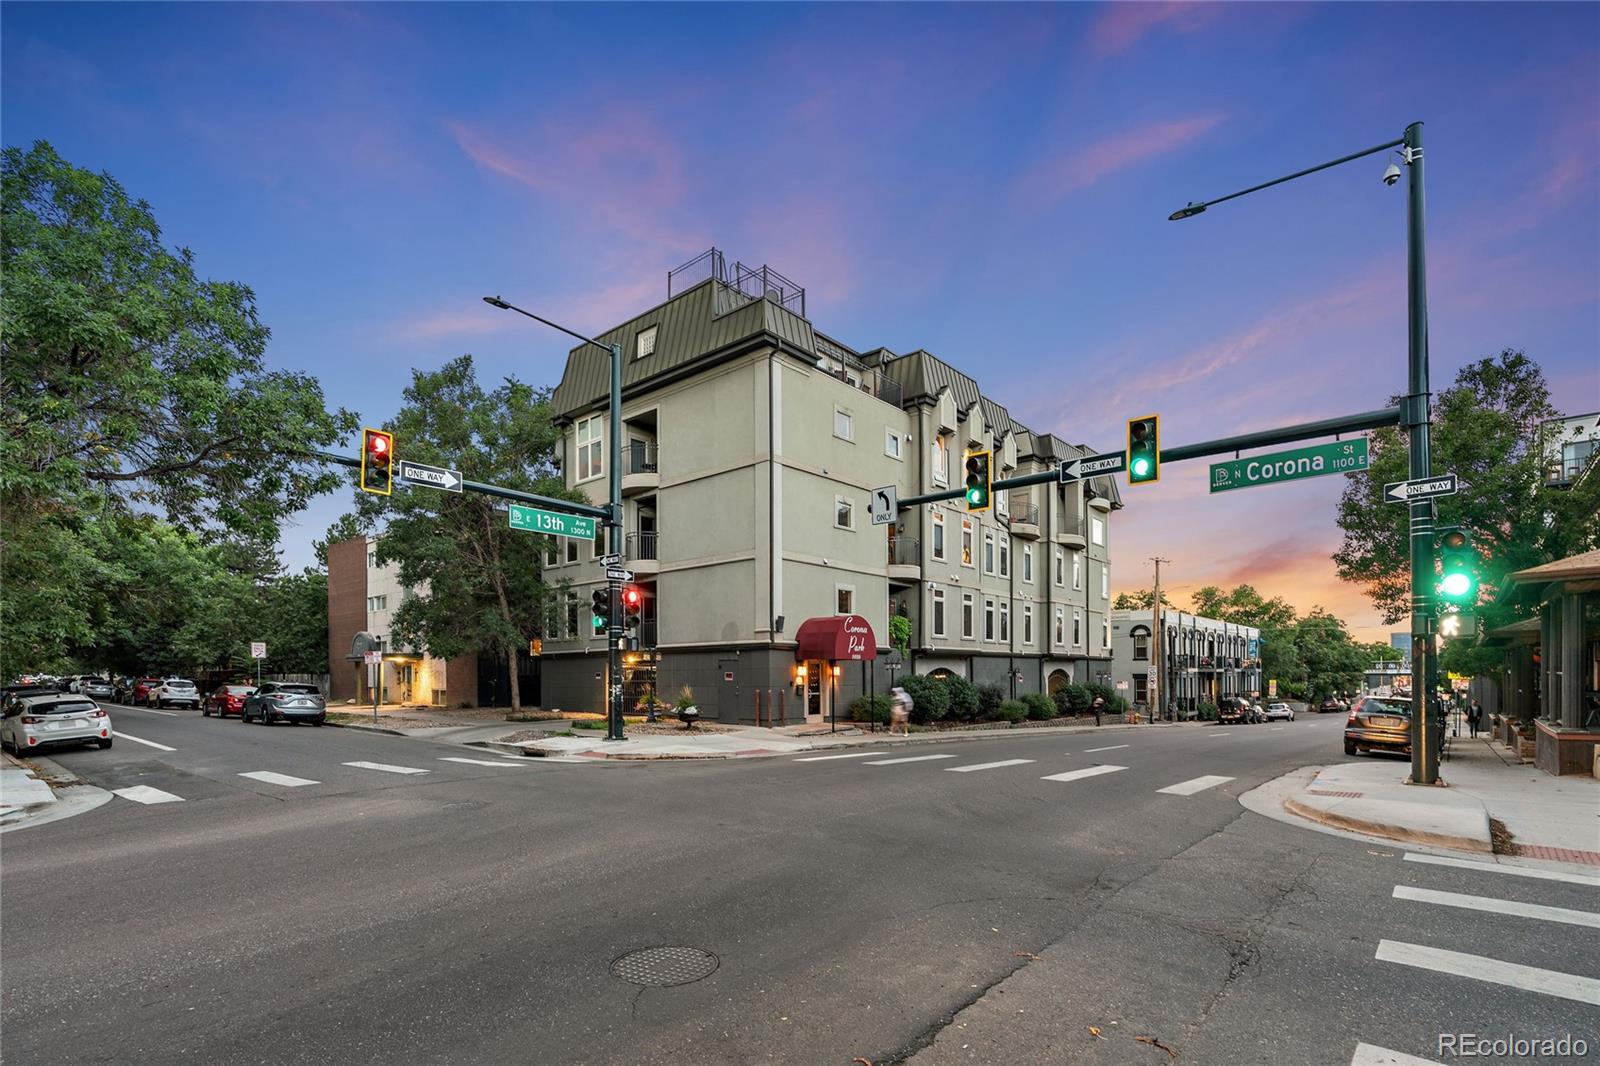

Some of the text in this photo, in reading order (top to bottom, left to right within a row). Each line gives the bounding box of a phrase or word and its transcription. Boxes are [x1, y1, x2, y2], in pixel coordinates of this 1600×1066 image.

[1343, 445, 1354, 454] St
[1080, 459, 1116, 472] ONE WAY
[1234, 455, 1324, 481] N Corona
[1332, 455, 1365, 469] 1100 E
[407, 468, 444, 483] ONE WAY
[1406, 481, 1449, 494] ONE WAY
[537, 513, 564, 531] 13th
[876, 512, 892, 522] ONLY
[575, 520, 586, 528] Ave
[571, 527, 585, 535] 1300
[844, 616, 868, 633] Corona
[848, 635, 865, 653] Park
